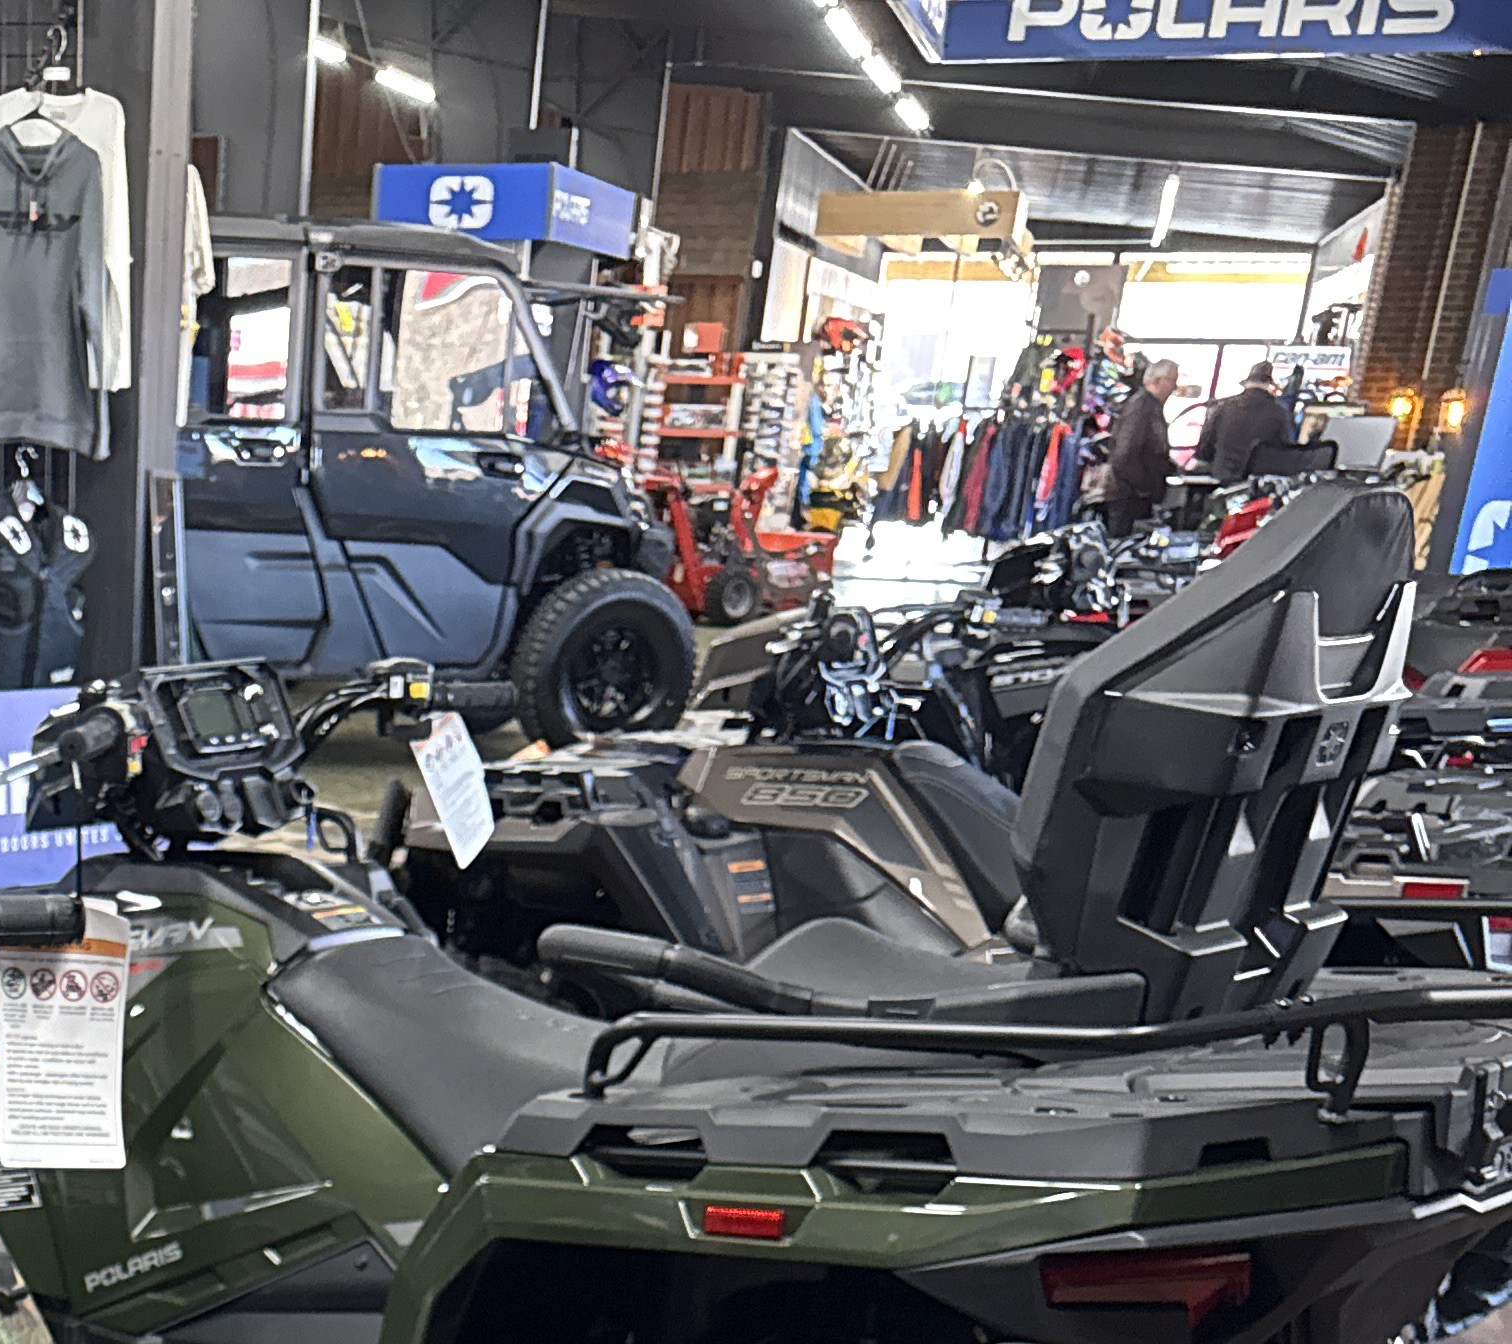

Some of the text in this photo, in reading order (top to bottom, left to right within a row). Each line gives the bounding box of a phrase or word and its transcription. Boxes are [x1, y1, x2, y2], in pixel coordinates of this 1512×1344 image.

[1007, 0, 1457, 41] POLARIS
[740, 782, 870, 808] 850
[54, 825, 109, 848] UNTES
[84, 1241, 183, 1293] POLARIS
